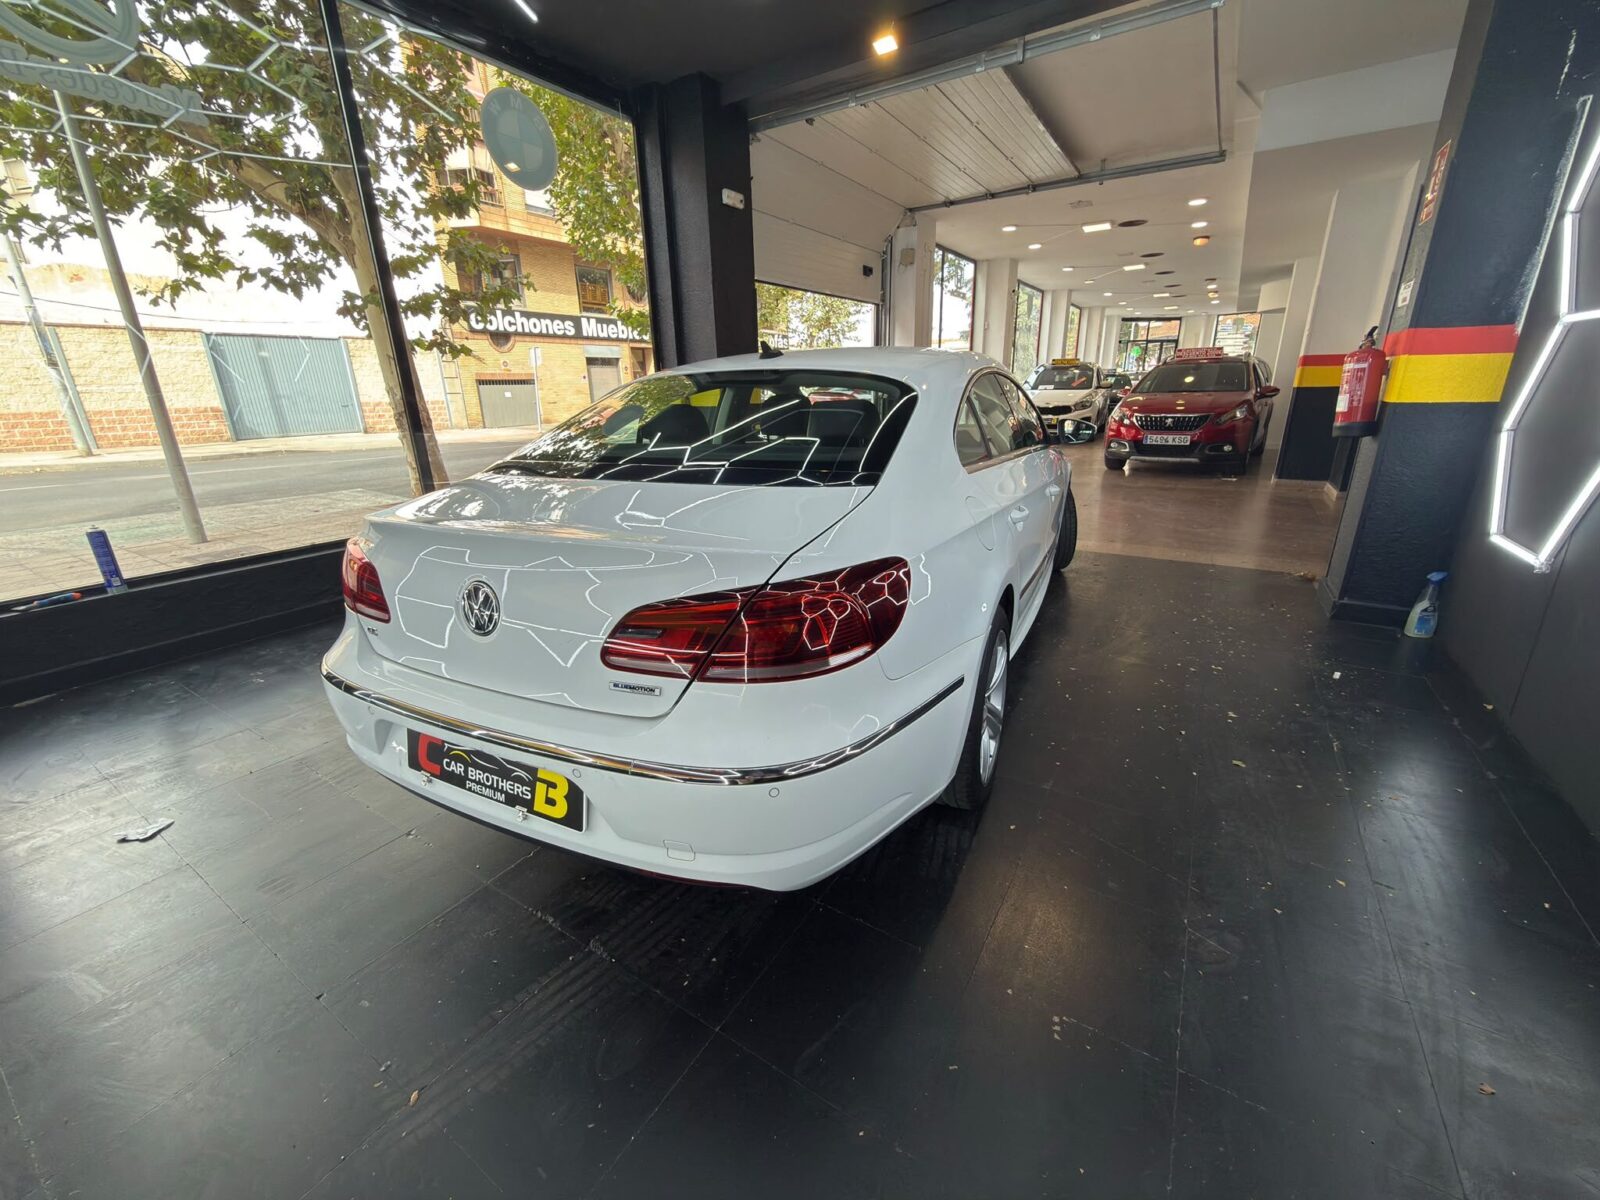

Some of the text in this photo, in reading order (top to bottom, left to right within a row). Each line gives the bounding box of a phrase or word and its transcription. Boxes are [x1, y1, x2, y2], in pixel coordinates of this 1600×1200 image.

[469, 309, 576, 336] Colchones
[1172, 436, 1189, 444] KSG
[613, 682, 656, 693] BLUEMOTION
[443, 758, 532, 800] CAR BROTHERS
[466, 780, 506, 803] PREMIUM
